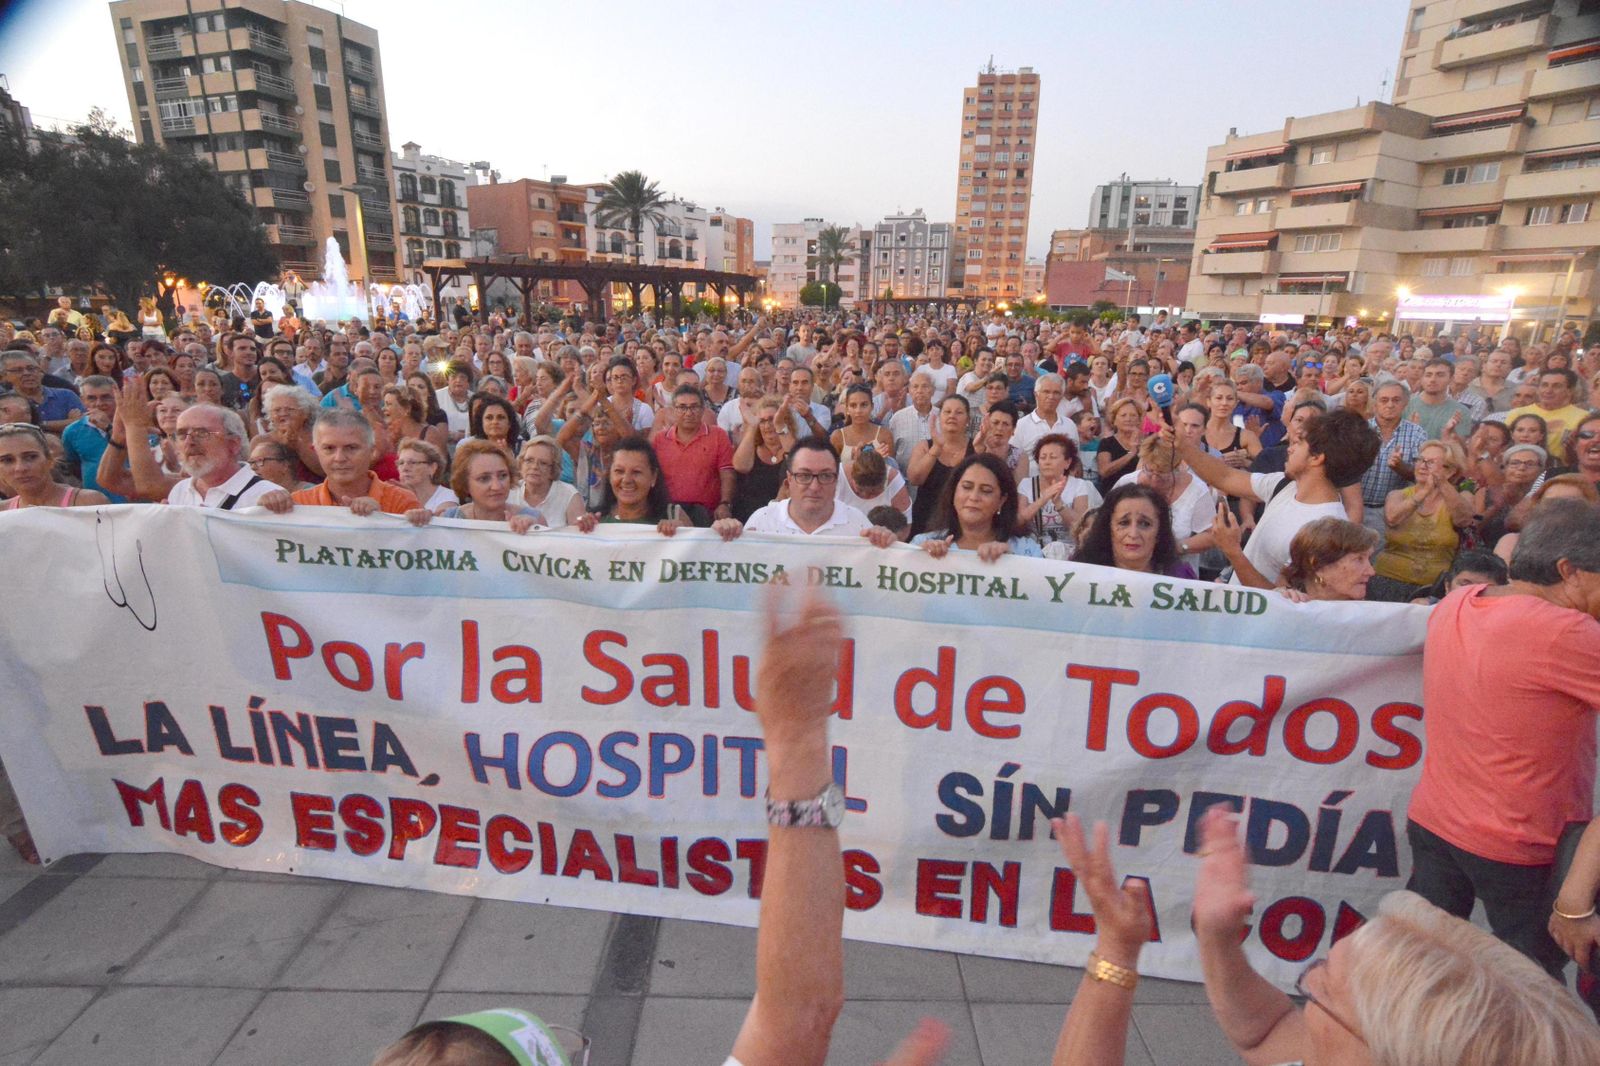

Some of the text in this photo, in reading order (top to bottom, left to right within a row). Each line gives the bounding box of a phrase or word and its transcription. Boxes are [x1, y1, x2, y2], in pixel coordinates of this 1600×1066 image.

[276, 539, 1267, 616] PLATAFORMA CIVICA EN DEFENSA DEL HOSPITAL Y LA SALUD
[261, 611, 425, 701] Por
[460, 620, 543, 703] la
[894, 646, 1026, 739] de
[1066, 664, 1424, 770] Todos
[84, 701, 195, 756] LA
[463, 731, 868, 813] HOSPITL
[935, 762, 1071, 839] SÍN
[113, 778, 263, 845] MAS
[291, 791, 882, 912] ESPECIALISTS
[916, 858, 1021, 928] EN
